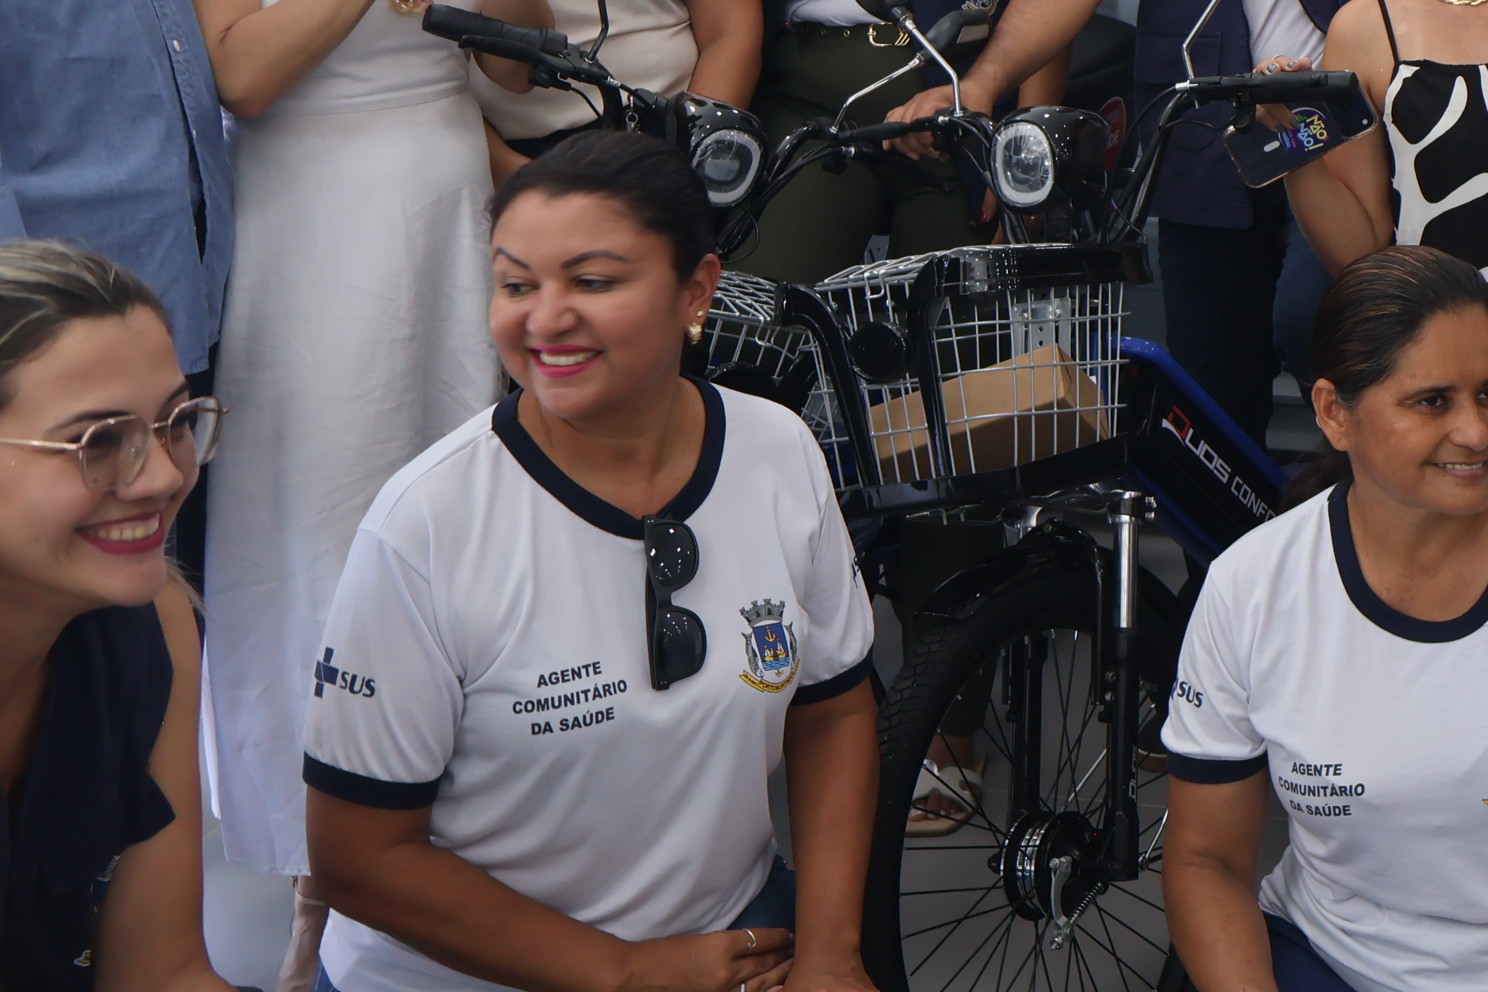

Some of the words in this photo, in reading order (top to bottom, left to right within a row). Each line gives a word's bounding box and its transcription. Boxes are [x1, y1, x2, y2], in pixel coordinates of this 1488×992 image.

[1306, 114, 1328, 140] NÃO
[1162, 405, 1232, 484] DUOS
[1231, 475, 1277, 523] CONFO
[340, 671, 376, 698] SUS
[537, 661, 602, 688] AGENTE
[512, 679, 628, 714] COMUNITÁRIO
[1177, 681, 1203, 708] SUS
[531, 721, 554, 735] DA
[559, 706, 615, 732] SAÚDE
[1291, 762, 1343, 777] AGENTE
[1278, 776, 1366, 797] COMUNITÁRIO
[1289, 799, 1304, 813] DA
[1306, 803, 1352, 817] SAÚDE
